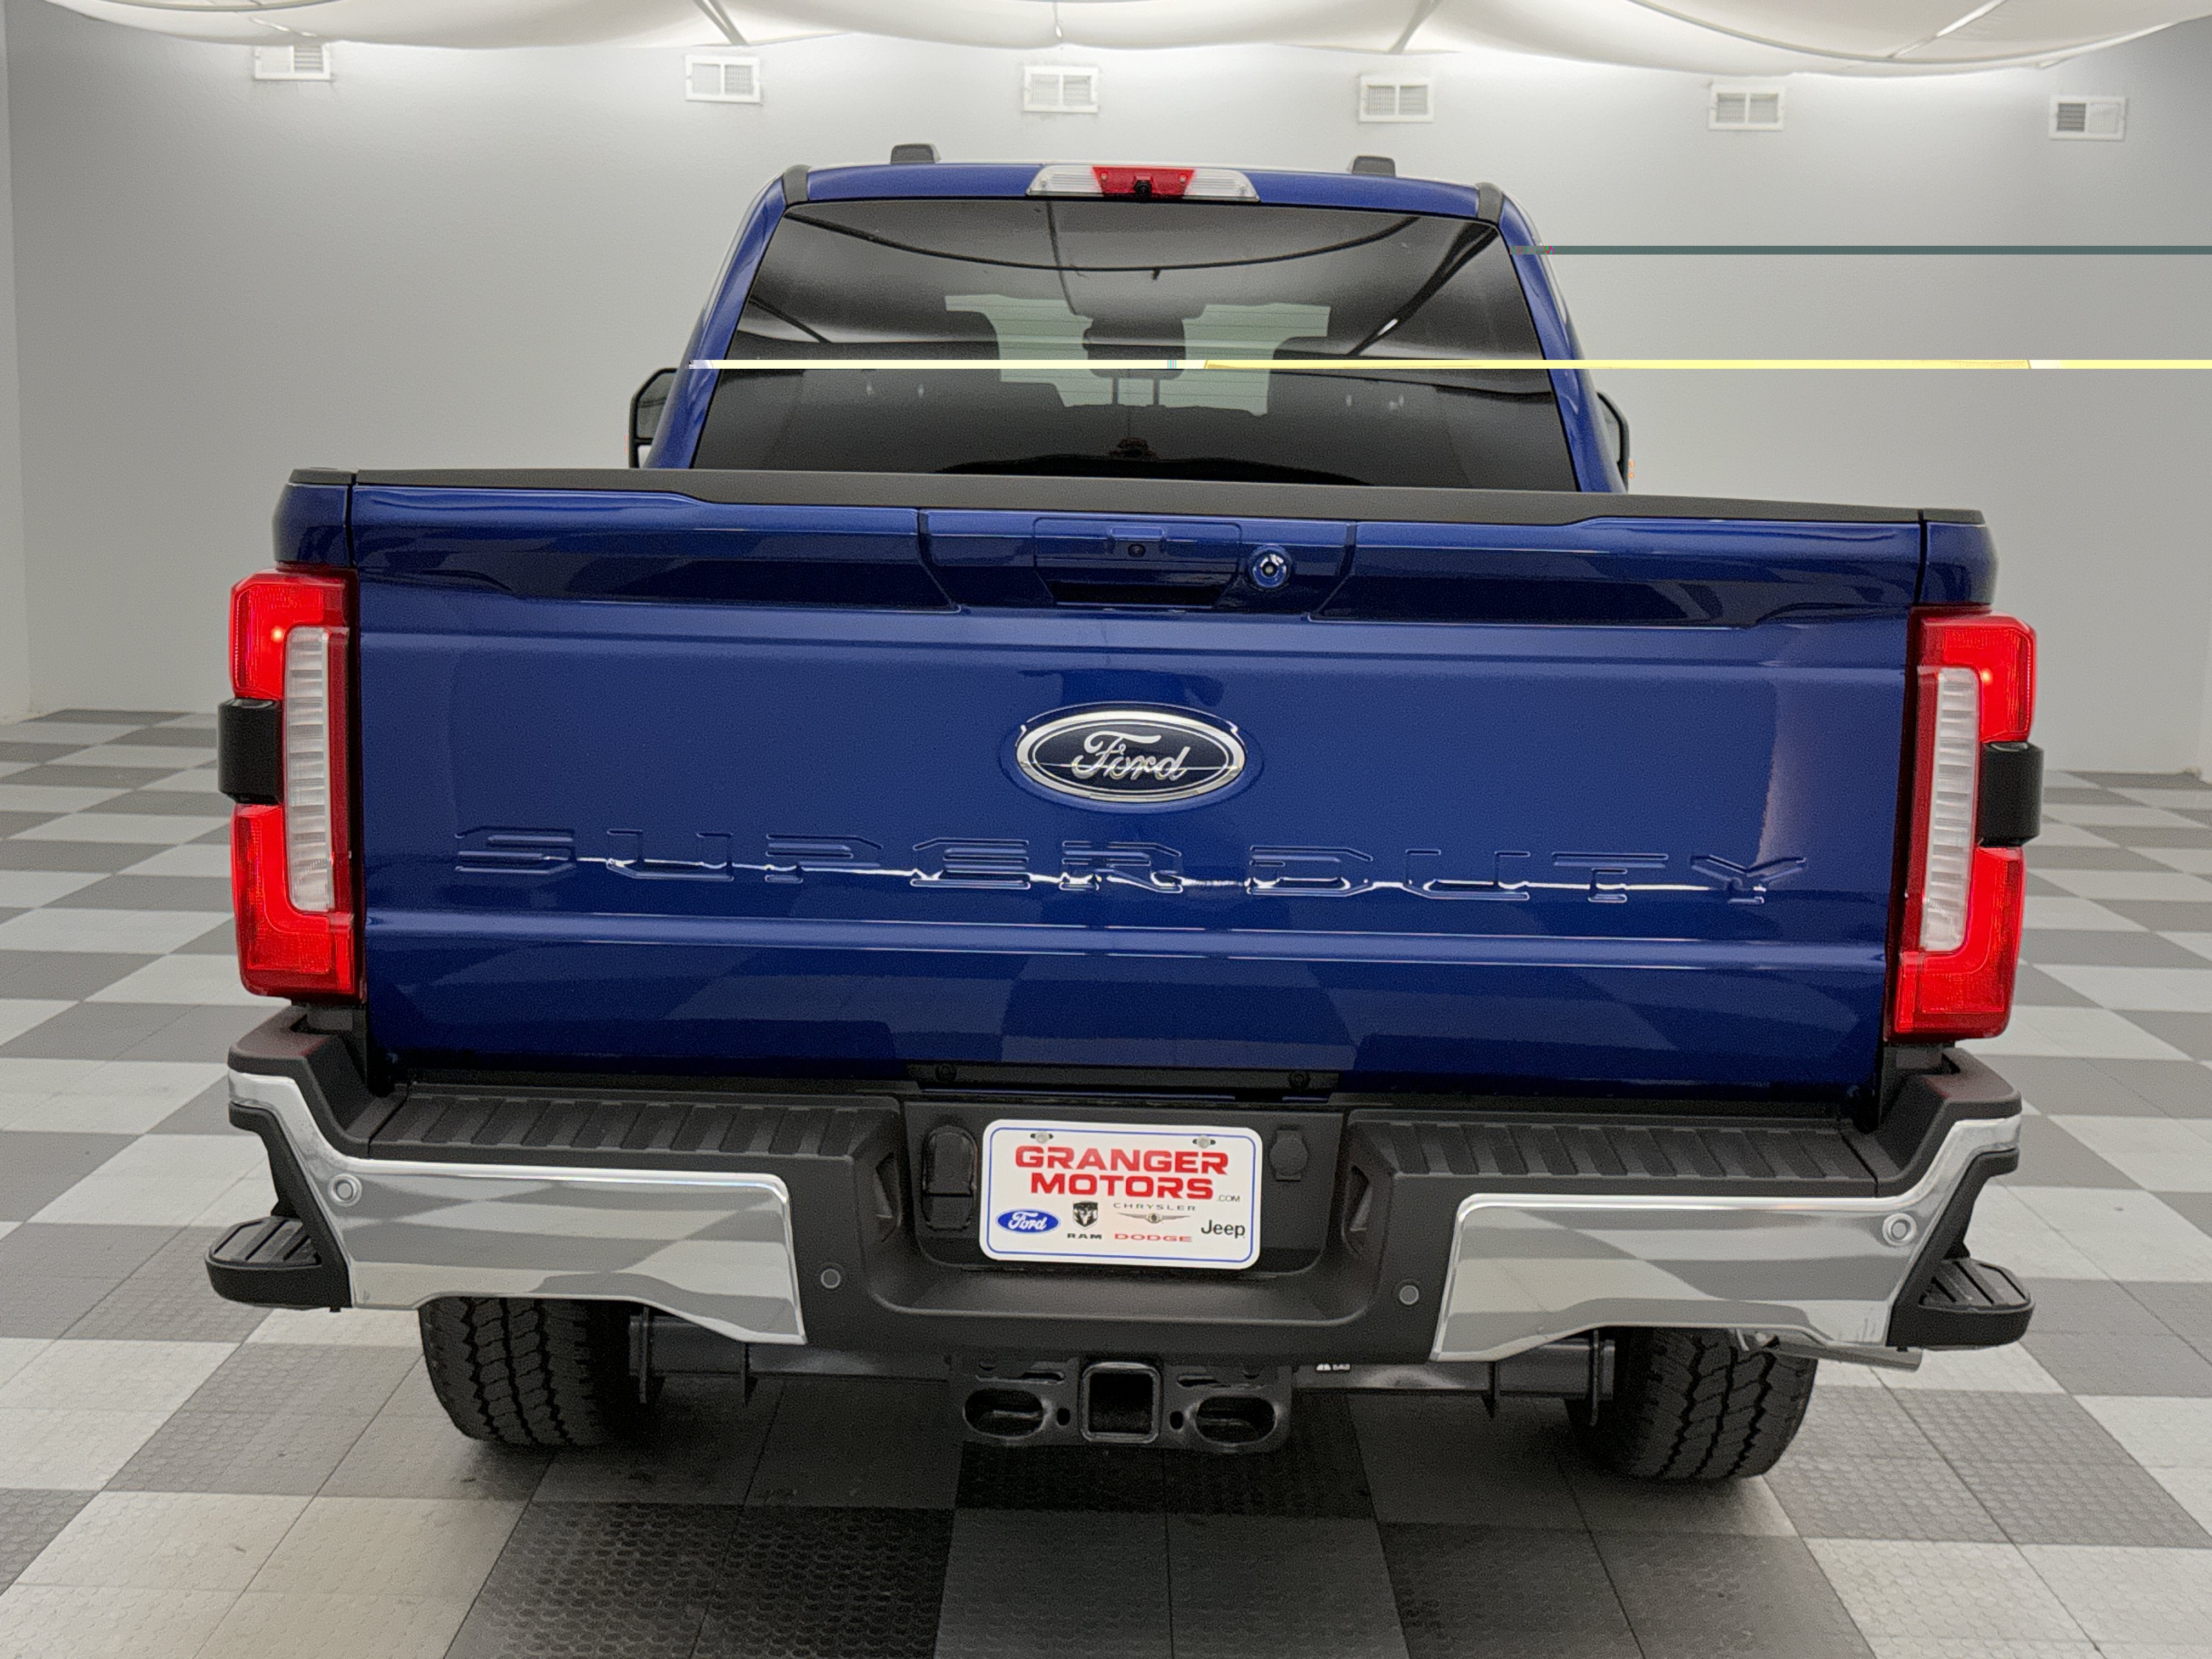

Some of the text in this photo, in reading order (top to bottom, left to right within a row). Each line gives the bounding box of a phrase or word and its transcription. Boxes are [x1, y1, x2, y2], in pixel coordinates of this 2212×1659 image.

[1071, 730, 1190, 781] Ford
[455, 826, 1806, 904] SUPER DUTY
[1015, 1145, 1229, 1176] GRANGER
[1030, 1172, 1214, 1200] MOTORS
[1113, 1202, 1197, 1211] CHRYSLER
[1007, 1211, 1048, 1231] Ford
[1200, 1220, 1246, 1239] Jeep
[1114, 1233, 1193, 1243] DODGE
